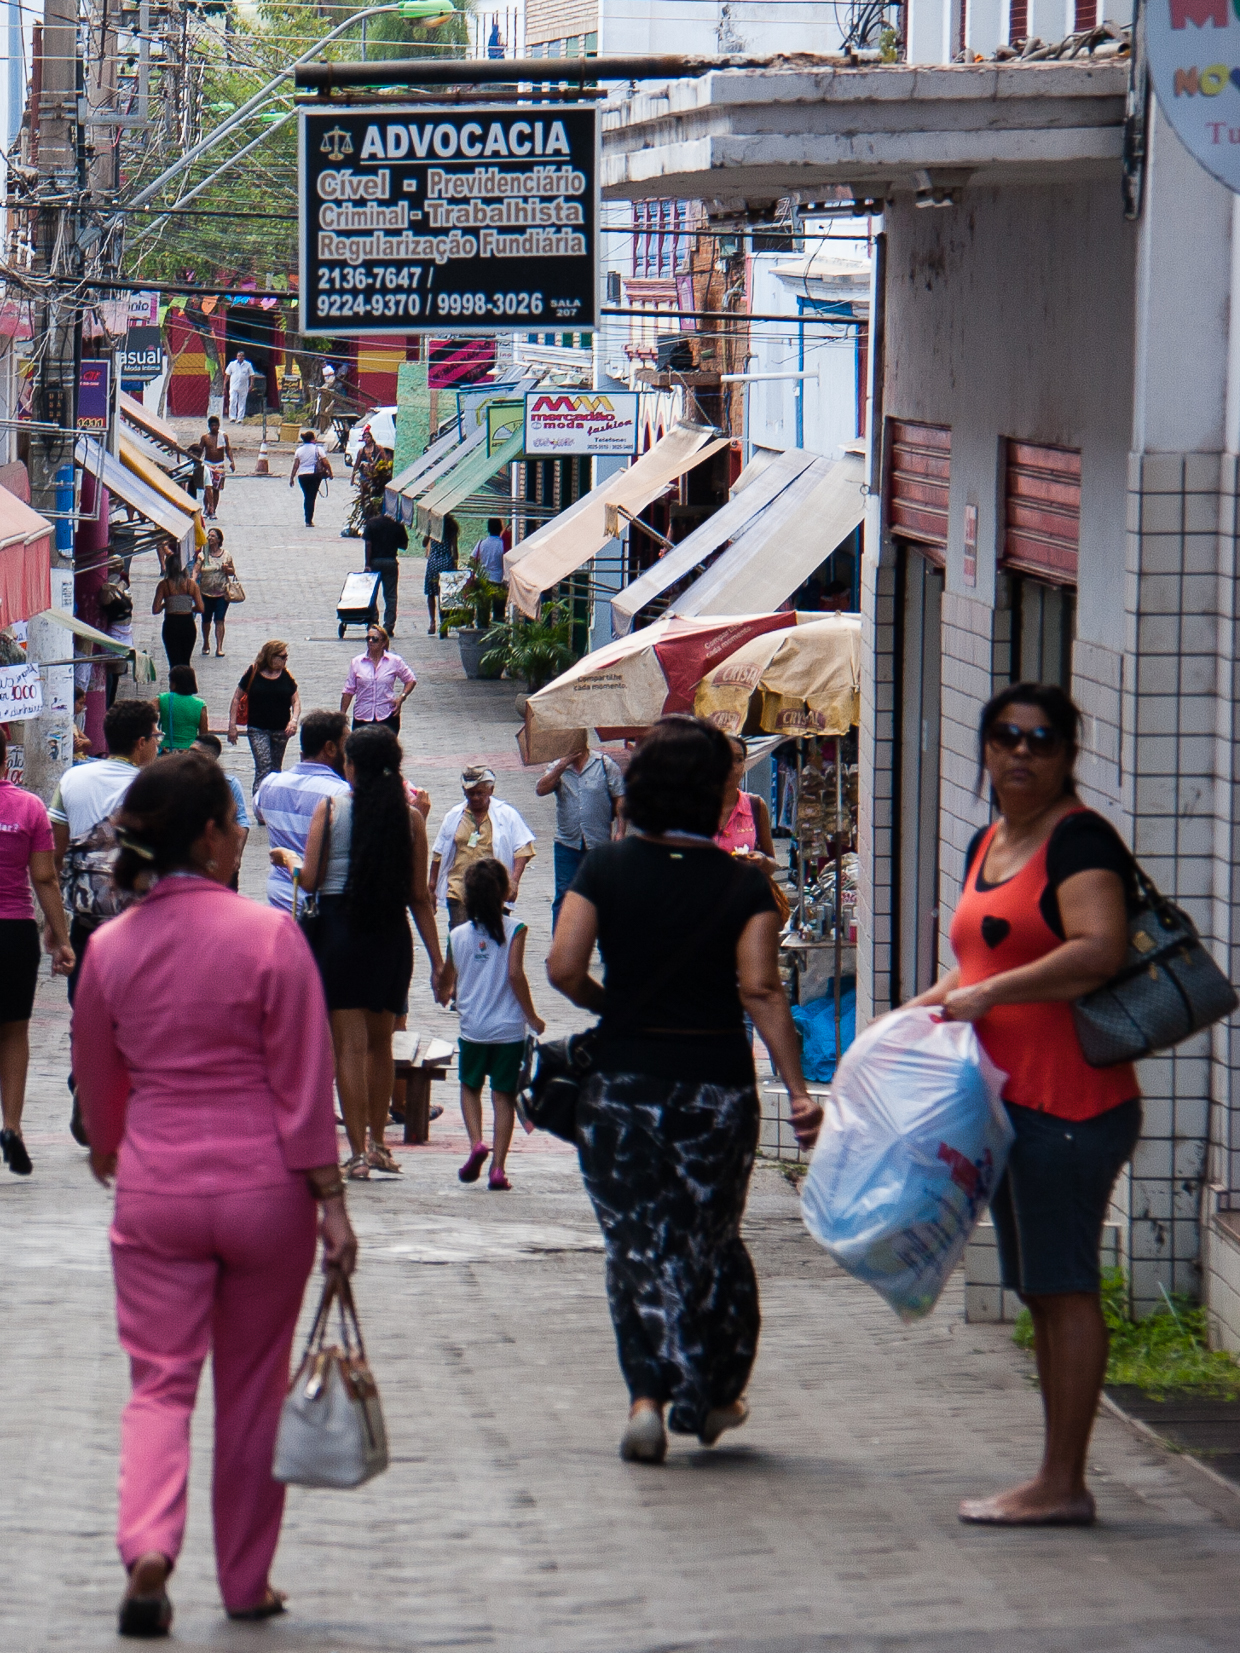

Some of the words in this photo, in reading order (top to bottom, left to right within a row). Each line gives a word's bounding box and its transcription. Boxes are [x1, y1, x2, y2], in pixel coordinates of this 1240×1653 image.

[360, 121, 570, 159] ADVOCACIA
[317, 168, 390, 199] Cível
[427, 165, 586, 198] Previdenciário
[319, 201, 408, 230] Criminal
[424, 196, 583, 227] Trabalhista
[318, 230, 477, 265] Regularização
[479, 227, 587, 258] Fundiária
[317, 267, 422, 290] 2136-7647
[317, 294, 420, 317] 9224-9370
[437, 292, 543, 316] 9998-3026
[550, 299, 581, 308] SALA
[556, 308, 577, 317] 207
[530, 411, 615, 421] mercadão
[543, 421, 584, 429] moda
[587, 419, 632, 436] fashion
